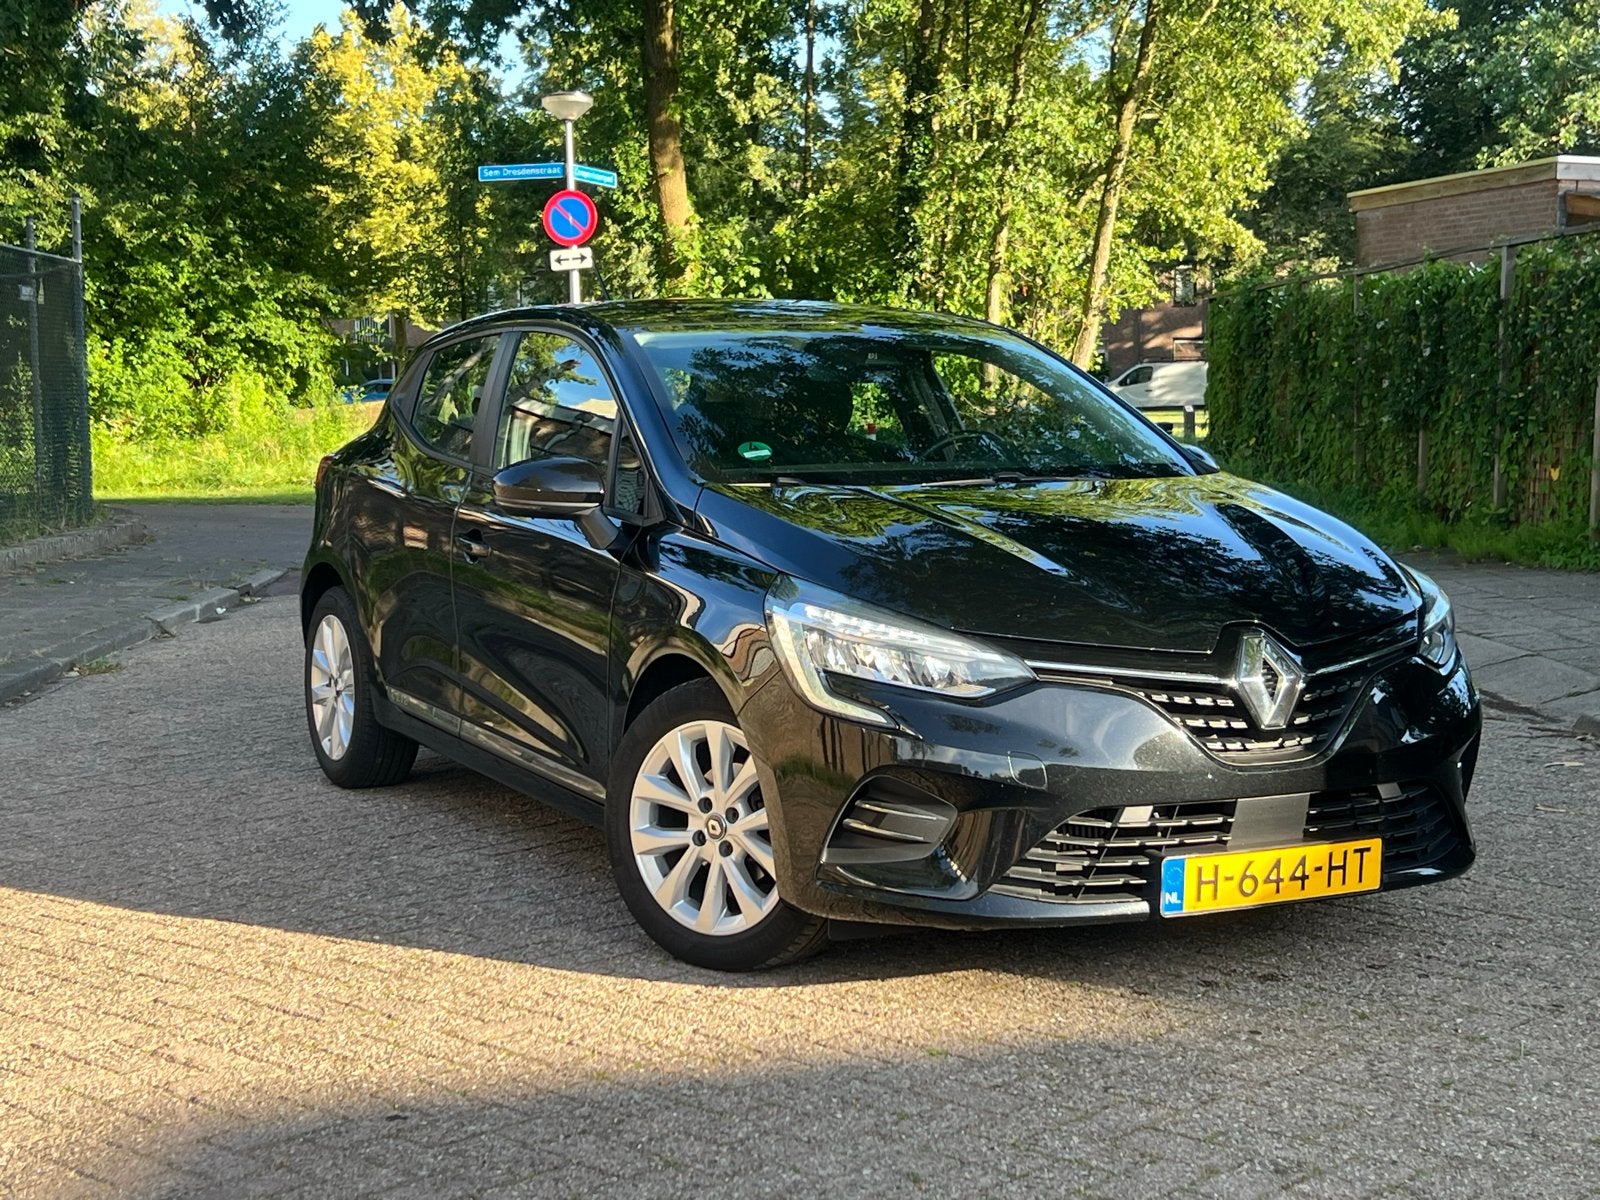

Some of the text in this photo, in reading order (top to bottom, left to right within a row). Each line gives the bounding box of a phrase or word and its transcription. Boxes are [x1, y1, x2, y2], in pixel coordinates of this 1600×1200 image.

[483, 166, 561, 177] Sem Dresdenstraat
[1165, 847, 1372, 905] NL H-644-HT
